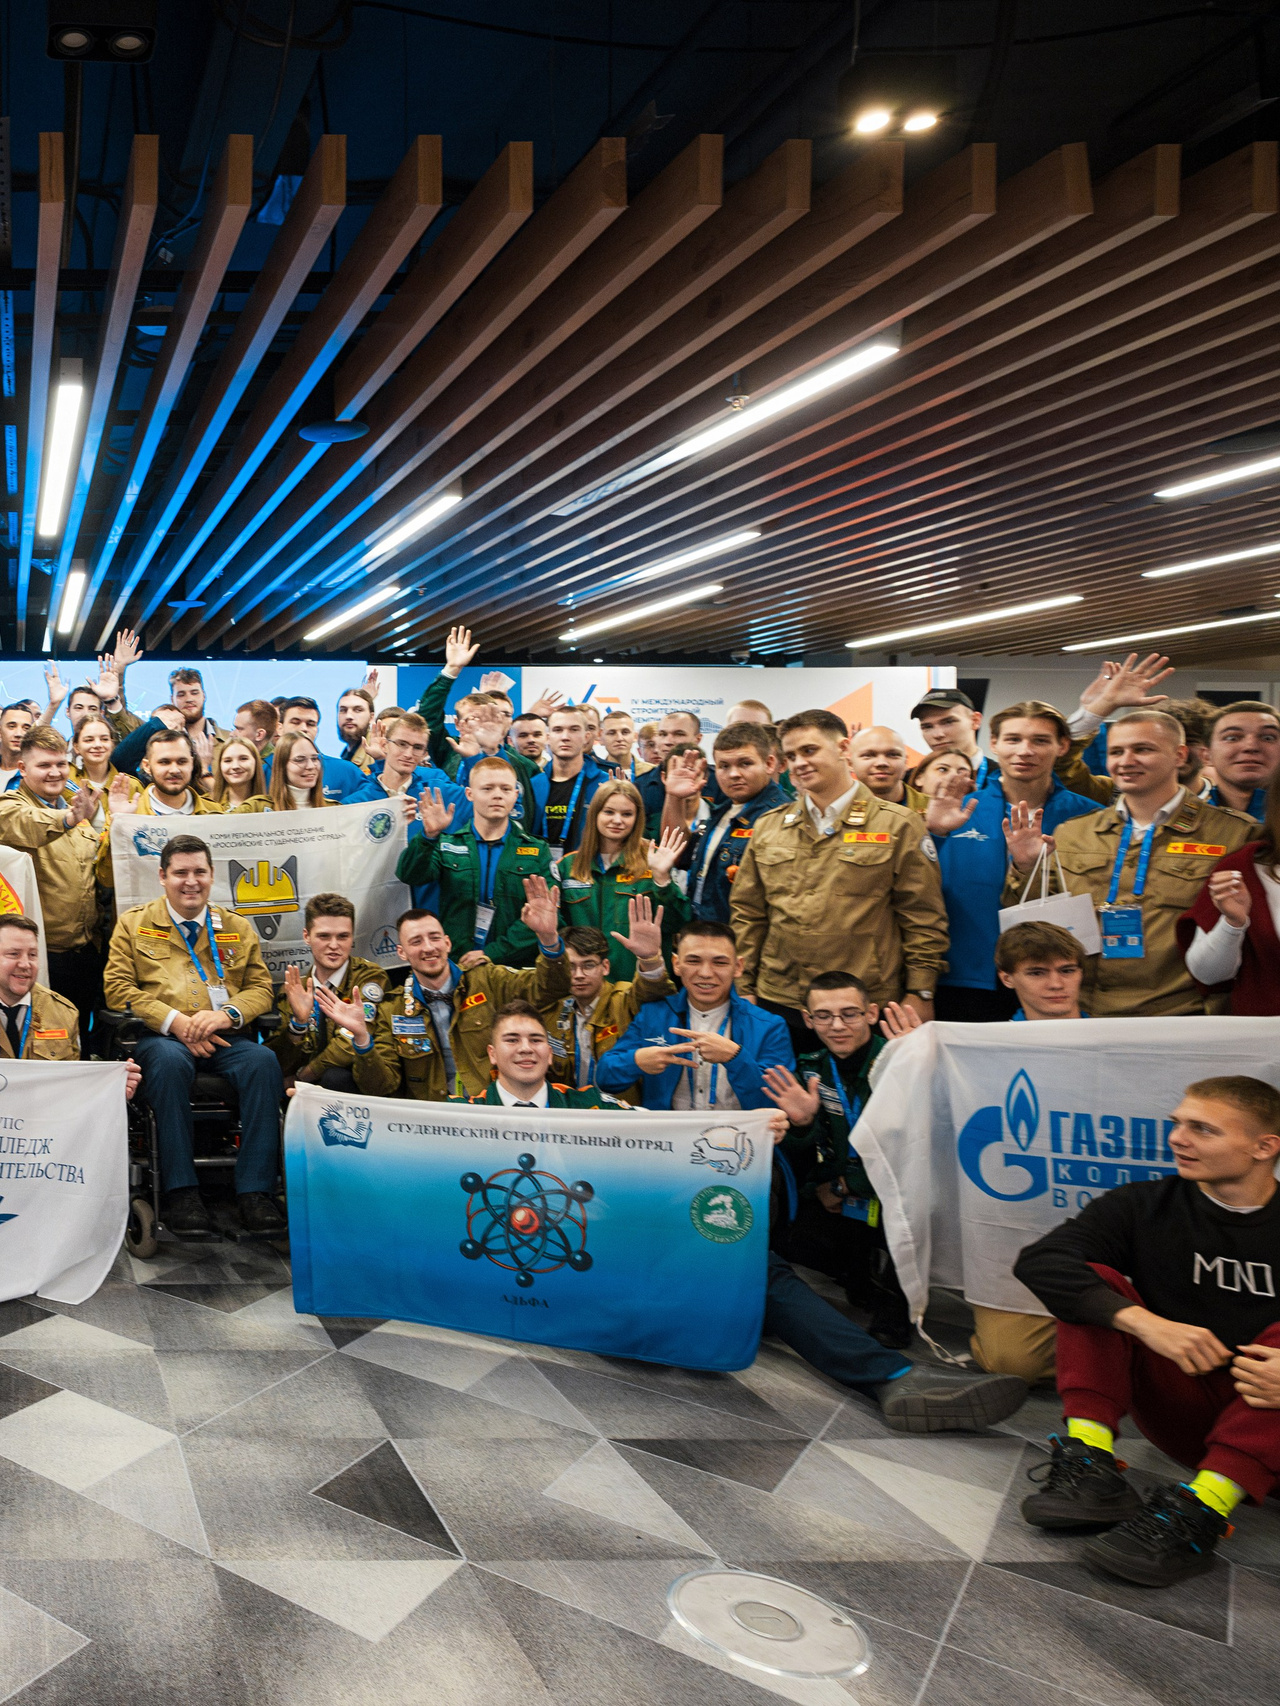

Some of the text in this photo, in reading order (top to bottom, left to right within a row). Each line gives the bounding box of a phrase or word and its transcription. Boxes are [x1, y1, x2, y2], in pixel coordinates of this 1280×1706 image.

[345, 1105, 370, 1120] РСО
[386, 1122, 674, 1153] СТУДЕНЧЕСКИЙ СТРОИТЕЛЬНЫЙ ОТРЯД
